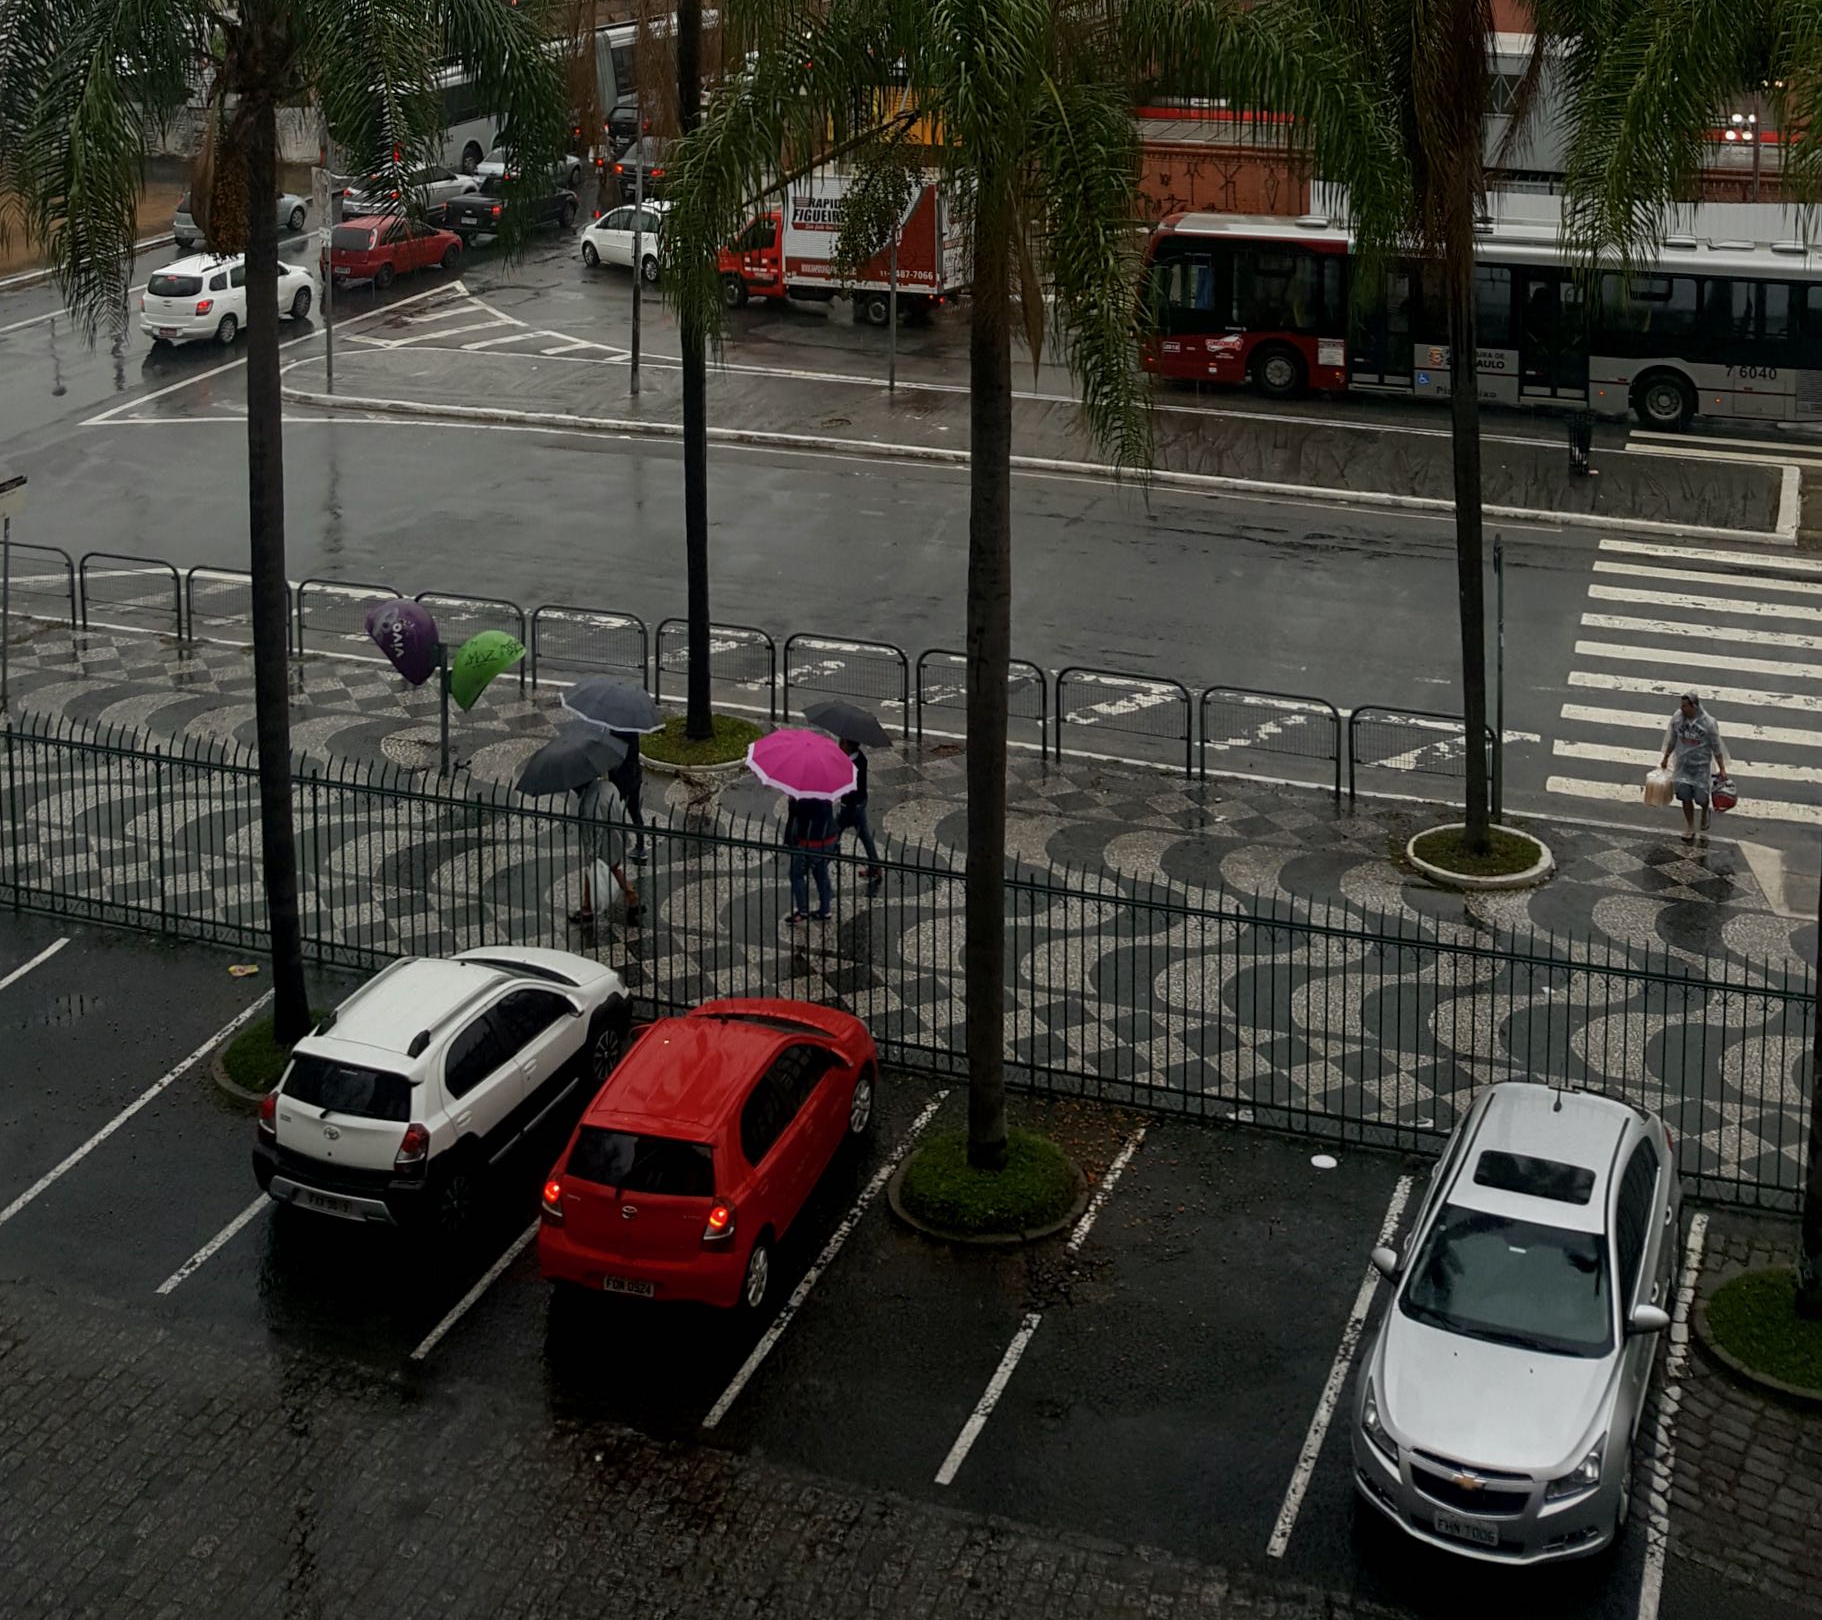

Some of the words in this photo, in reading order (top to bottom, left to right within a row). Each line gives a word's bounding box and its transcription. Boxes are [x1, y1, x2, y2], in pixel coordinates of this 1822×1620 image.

[808, 197, 841, 209] RAPID
[792, 209, 841, 223] FIGUEIR
[1476, 361, 1505, 370] AULO
[1739, 366, 1778, 380] 6040
[391, 622, 405, 658] vivo
